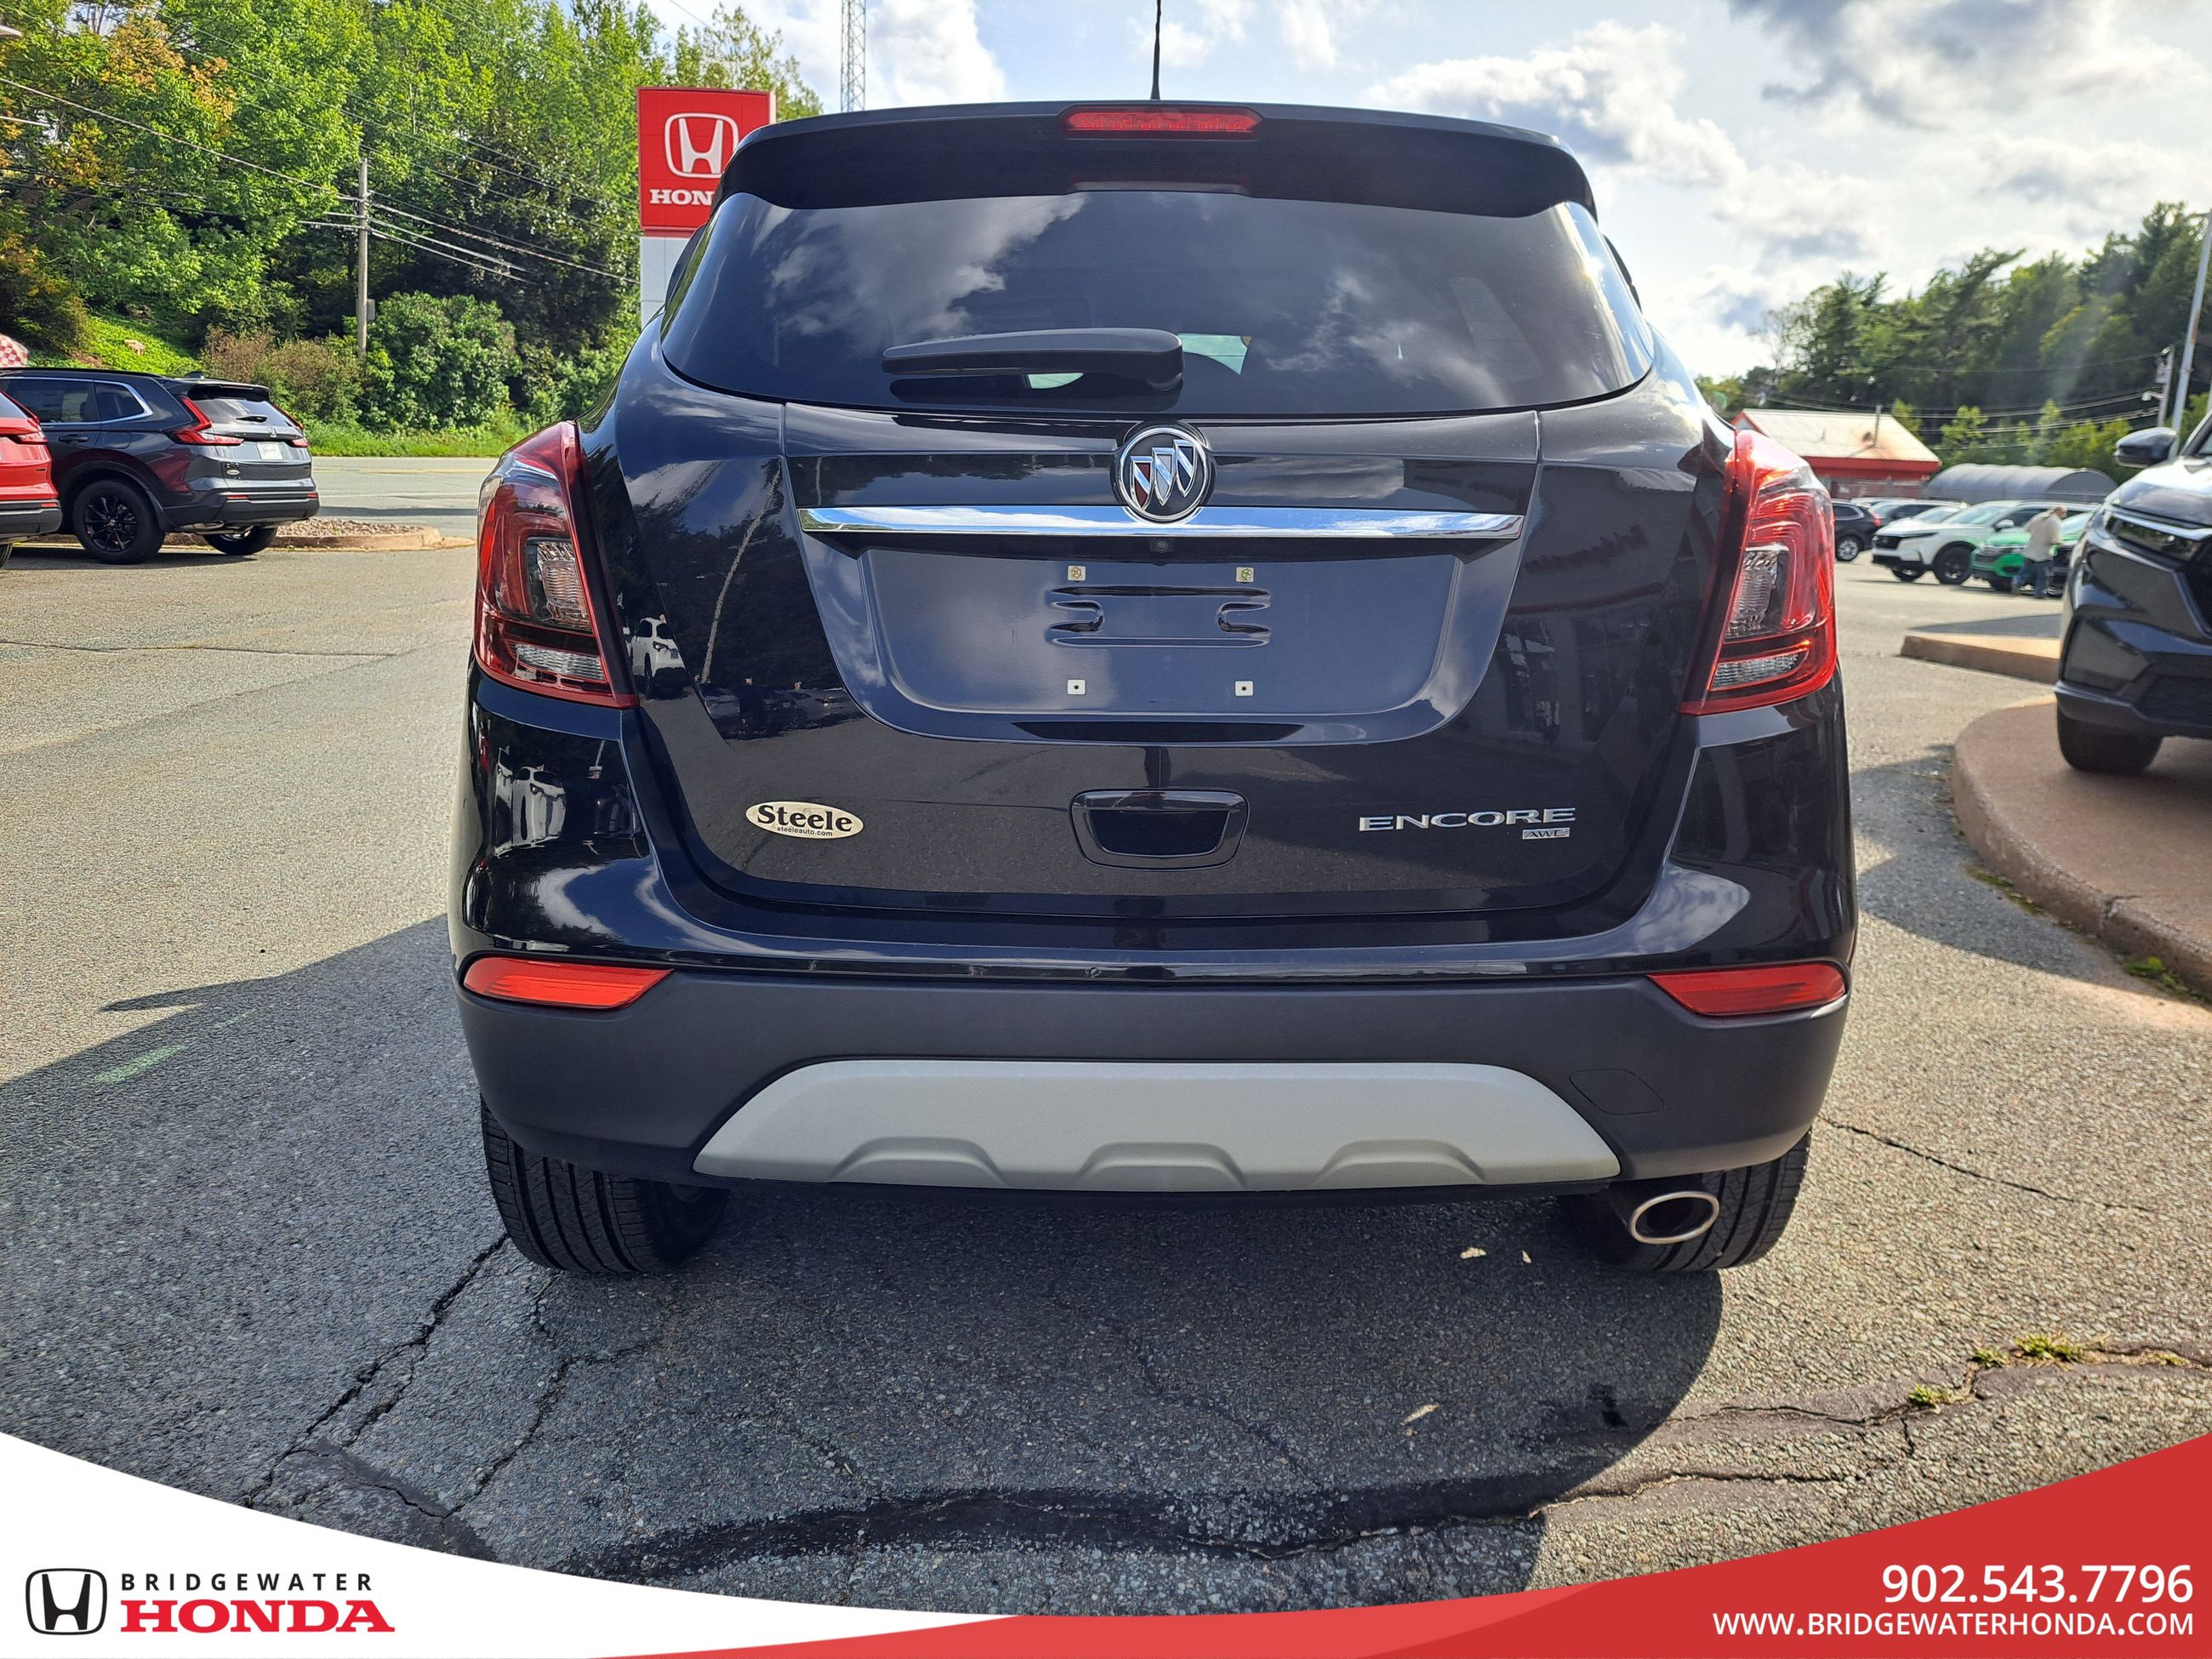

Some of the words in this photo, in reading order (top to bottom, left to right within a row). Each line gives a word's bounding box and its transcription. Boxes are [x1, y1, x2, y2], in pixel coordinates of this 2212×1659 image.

[649, 188, 715, 205] HON
[757, 804, 852, 832] Steele
[1359, 807, 1576, 832] ENCORE
[777, 826, 833, 837] steeleauto.com
[1524, 829, 1568, 838] AWD
